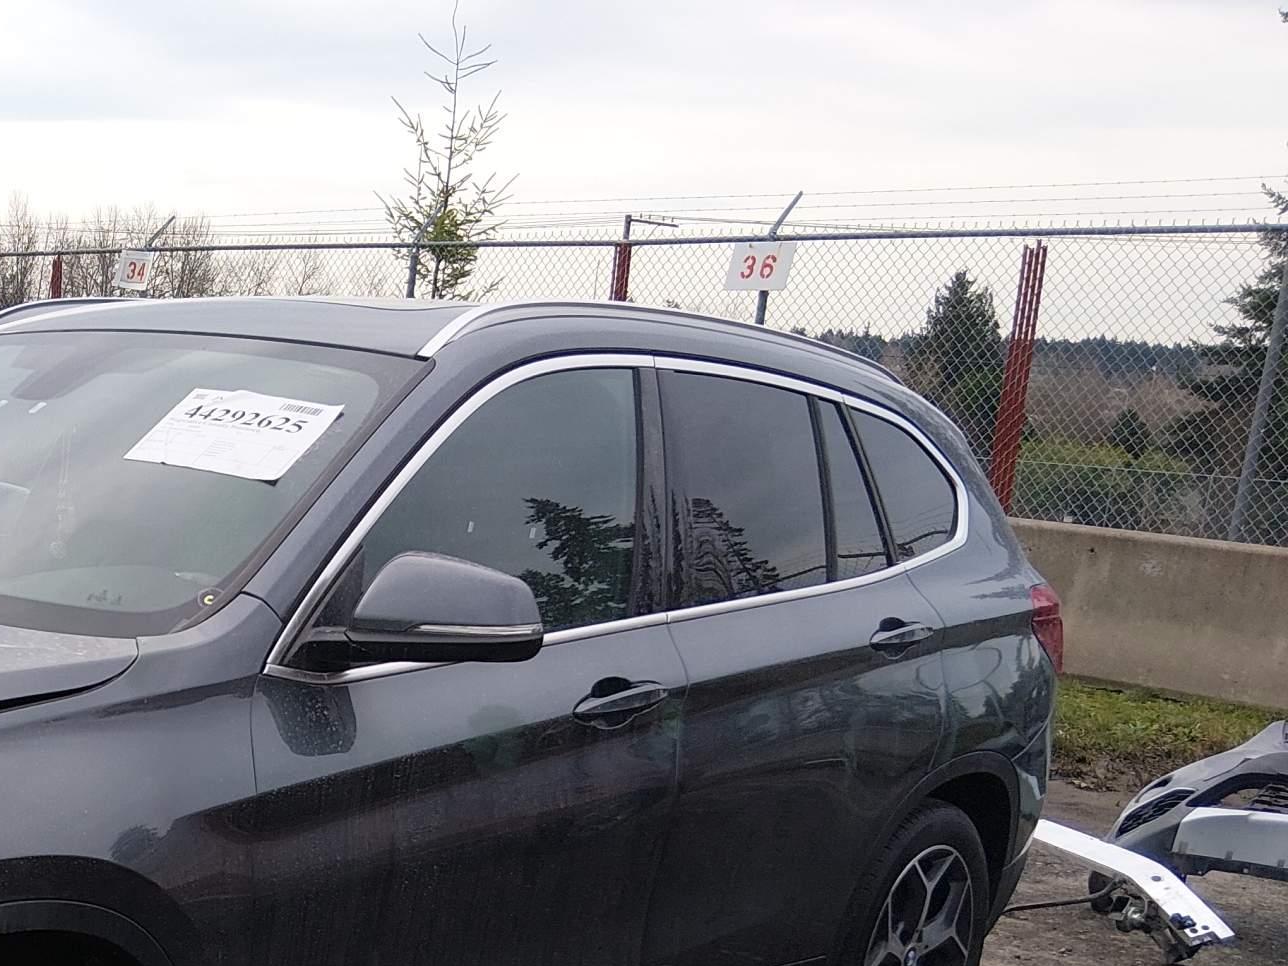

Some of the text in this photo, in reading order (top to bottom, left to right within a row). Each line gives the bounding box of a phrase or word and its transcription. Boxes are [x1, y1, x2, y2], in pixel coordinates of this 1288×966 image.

[126, 261, 146, 281] 34
[740, 254, 777, 279] 36
[184, 404, 309, 435] 44292625
